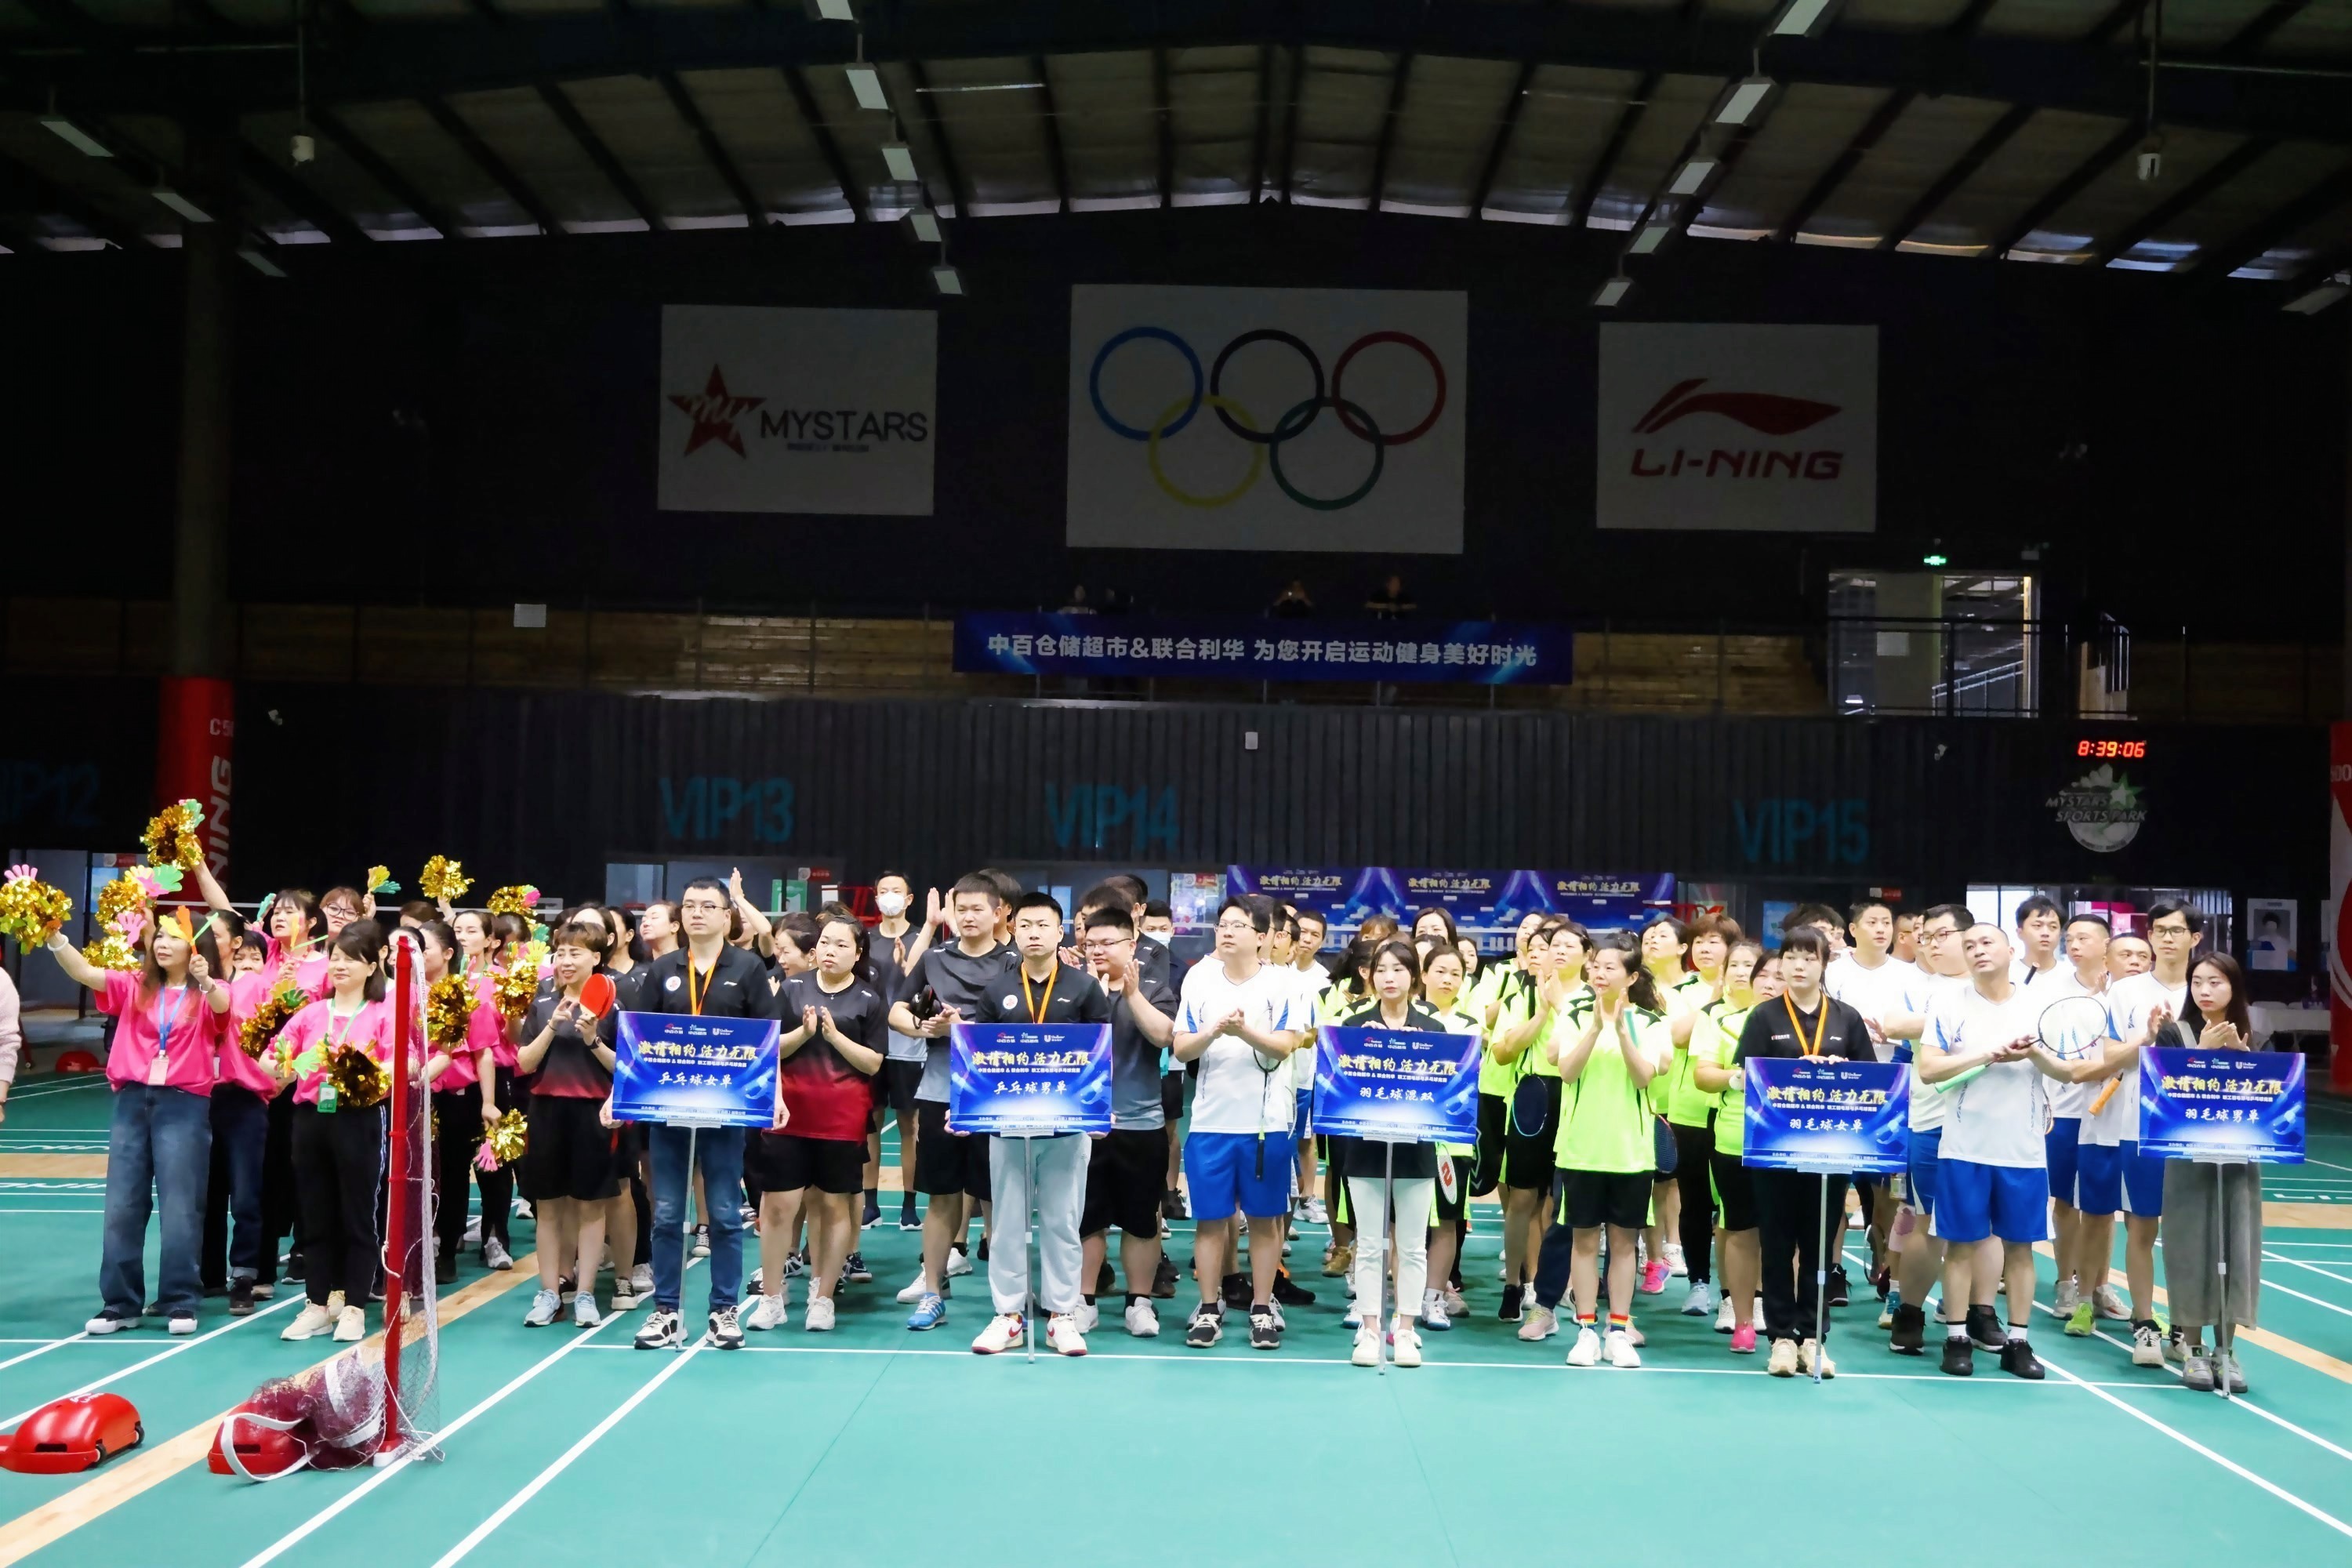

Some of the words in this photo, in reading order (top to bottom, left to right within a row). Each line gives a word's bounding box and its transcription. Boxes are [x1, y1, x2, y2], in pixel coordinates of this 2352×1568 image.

[760, 410, 927, 441] MYSTARS
[1631, 449, 1843, 479] LI-NING
[988, 633, 1245, 660] 中百仓储超市&联合利华
[1254, 639, 1537, 666] 为您开启运动健身美好时光
[2078, 740, 2146, 758] 8:39:06
[0, 759, 100, 827] IP12
[2045, 794, 2109, 808] MYSTARS
[658, 775, 795, 843] VIP13
[1044, 782, 1179, 851] VIP14
[2055, 810, 2108, 822] SPORTS
[2112, 809, 2148, 822] PARK
[1731, 797, 1870, 866] VIP15
[638, 1040, 695, 1058] 激情相约
[701, 1044, 758, 1060] 活力无限
[972, 1051, 1029, 1067] 激情相约
[1033, 1051, 1092, 1066] 活力无限
[1338, 1054, 1396, 1072] 激情相约
[1400, 1058, 1458, 1076] 活力无限
[658, 1072, 732, 1088] 乒乓球女单
[993, 1080, 1067, 1094] 乒乓球男单
[2161, 1075, 2220, 1092] 激情相约
[2224, 1079, 2284, 1094] 活力无限
[1359, 1087, 1435, 1103] 羽毛球混双
[1766, 1086, 1825, 1102] 激情相约
[1830, 1089, 1888, 1105] 活力无限
[2185, 1108, 2259, 1123] 羽毛球男单
[1790, 1118, 1864, 1134] 羽毛球女单
